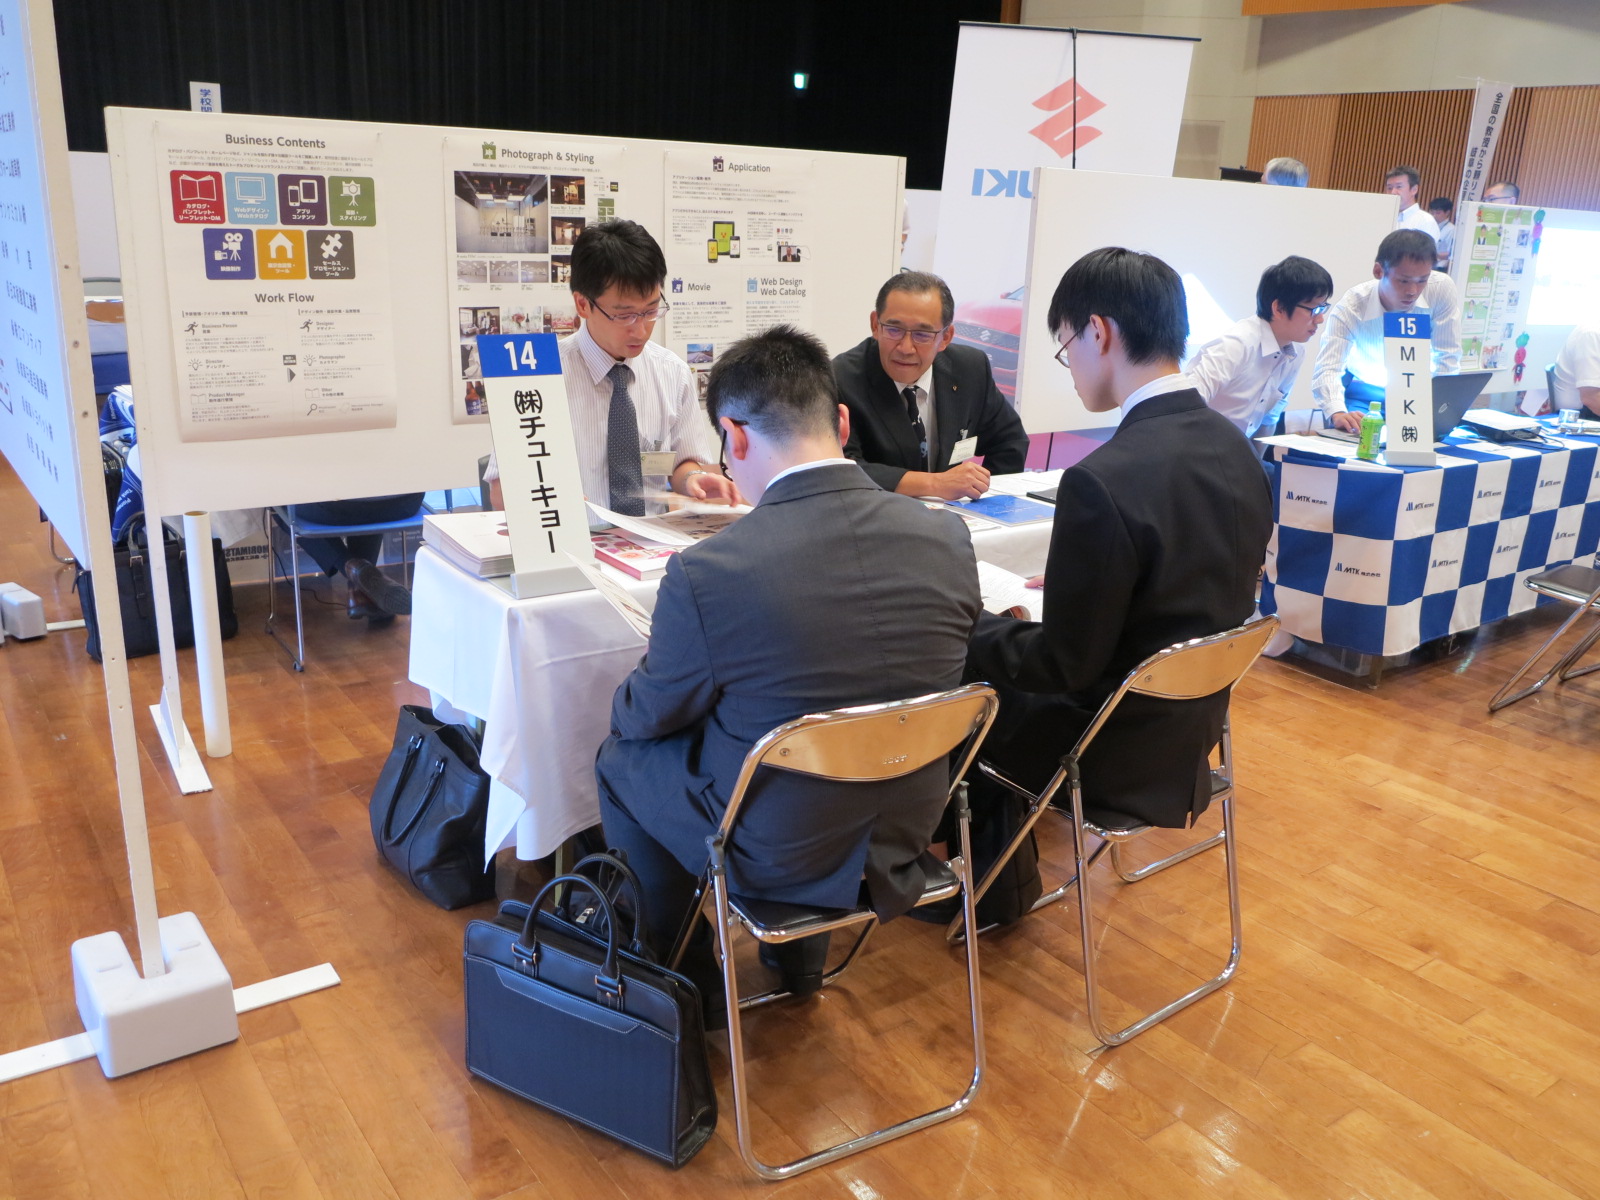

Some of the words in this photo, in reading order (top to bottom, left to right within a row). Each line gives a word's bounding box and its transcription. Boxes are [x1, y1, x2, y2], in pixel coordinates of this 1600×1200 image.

[225, 134, 274, 146] Business
[276, 136, 326, 149] Contents
[501, 148, 553, 162] Photograph
[556, 152, 563, 161] &
[565, 152, 595, 164] Styling
[728, 162, 771, 173] Application
[687, 282, 712, 291] Movie
[760, 278, 778, 286] Web
[780, 278, 803, 287] Design
[254, 293, 285, 303] Work
[288, 293, 314, 303] Flow
[760, 288, 778, 296] Web
[780, 288, 806, 298] Catalog
[1398, 317, 1417, 336] 15
[504, 340, 538, 371] 14
[514, 389, 561, 554] ㈱チューキョー
[1295, 495, 1311, 503] MTK
[1344, 566, 1360, 575] MTK
